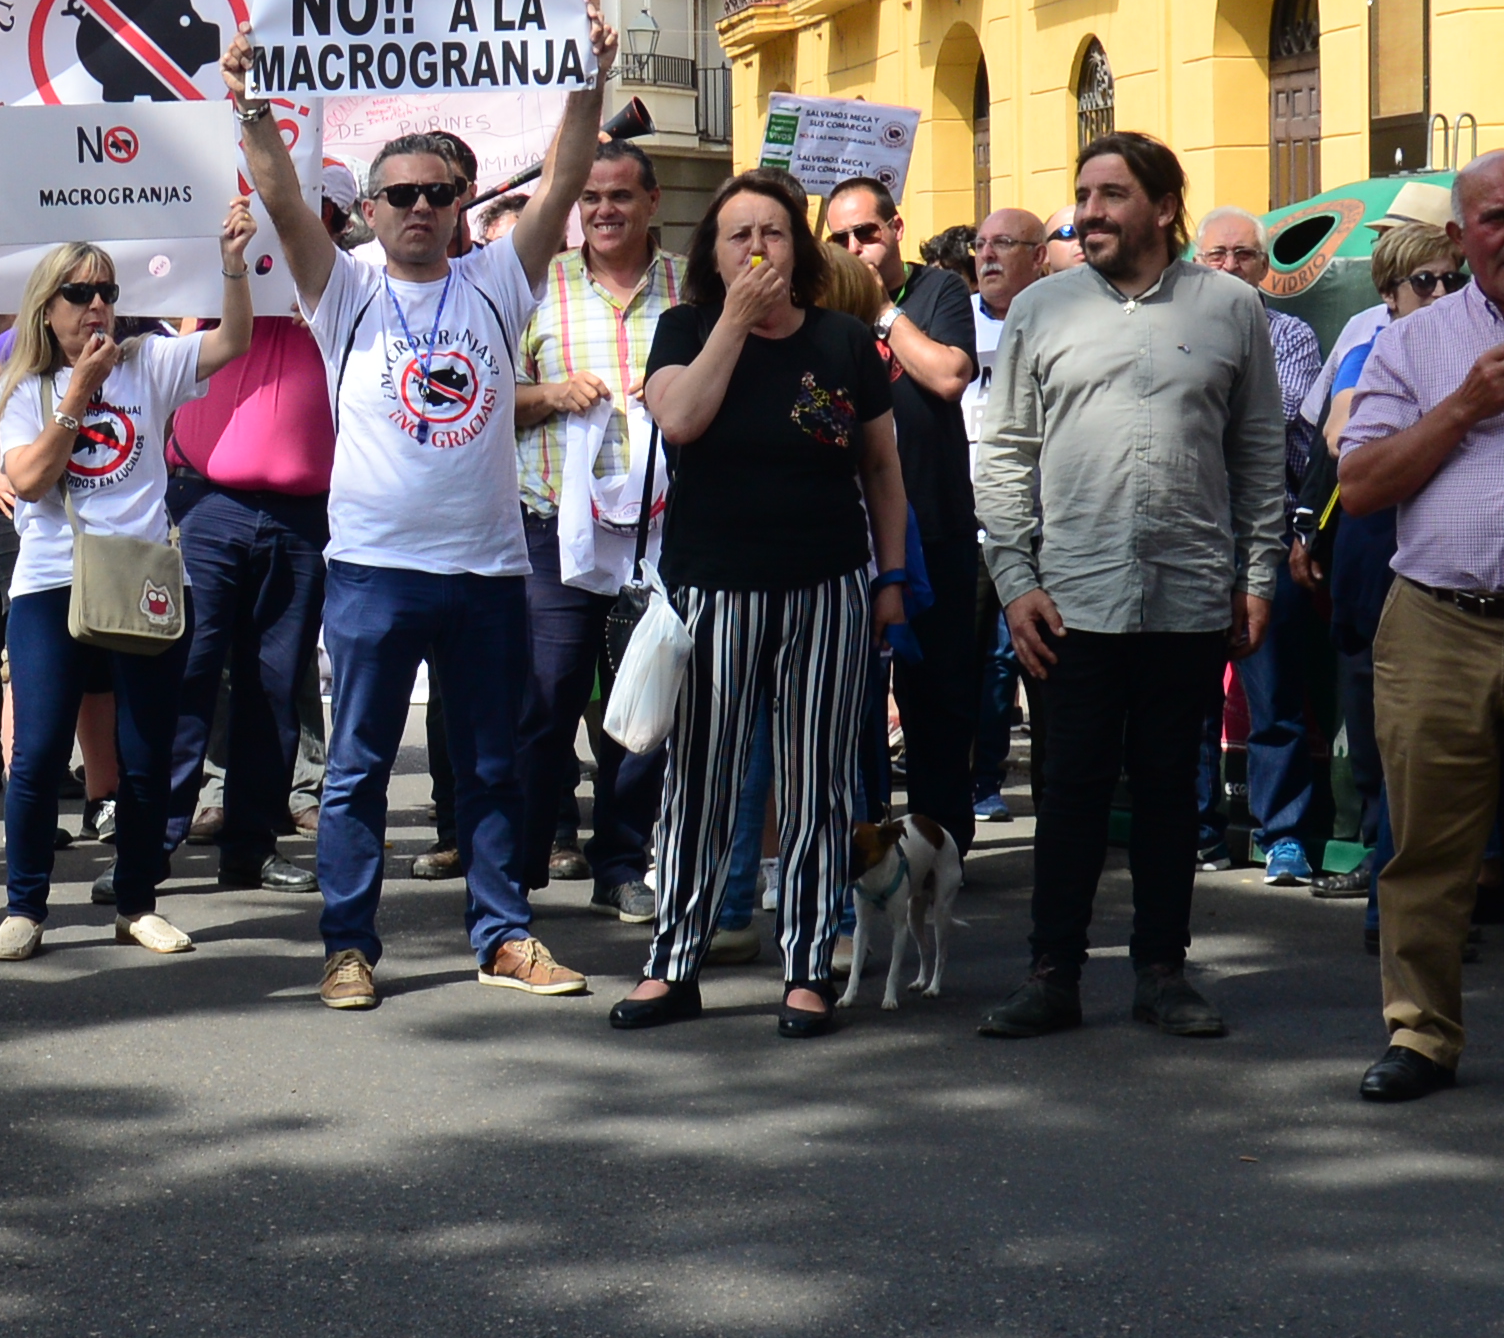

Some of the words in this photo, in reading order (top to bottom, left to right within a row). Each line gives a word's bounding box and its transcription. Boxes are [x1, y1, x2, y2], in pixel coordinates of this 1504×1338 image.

[252, 39, 586, 92] MACROGRANJA
[806, 109, 848, 120] SALVEMOS
[39, 185, 192, 207] MACROGRANJAS
[1272, 253, 1326, 293] VIDRIO
[431, 388, 498, 448] GRACIAS!
[100, 475, 114, 487] EN
[117, 435, 145, 482] LUCILLOS
